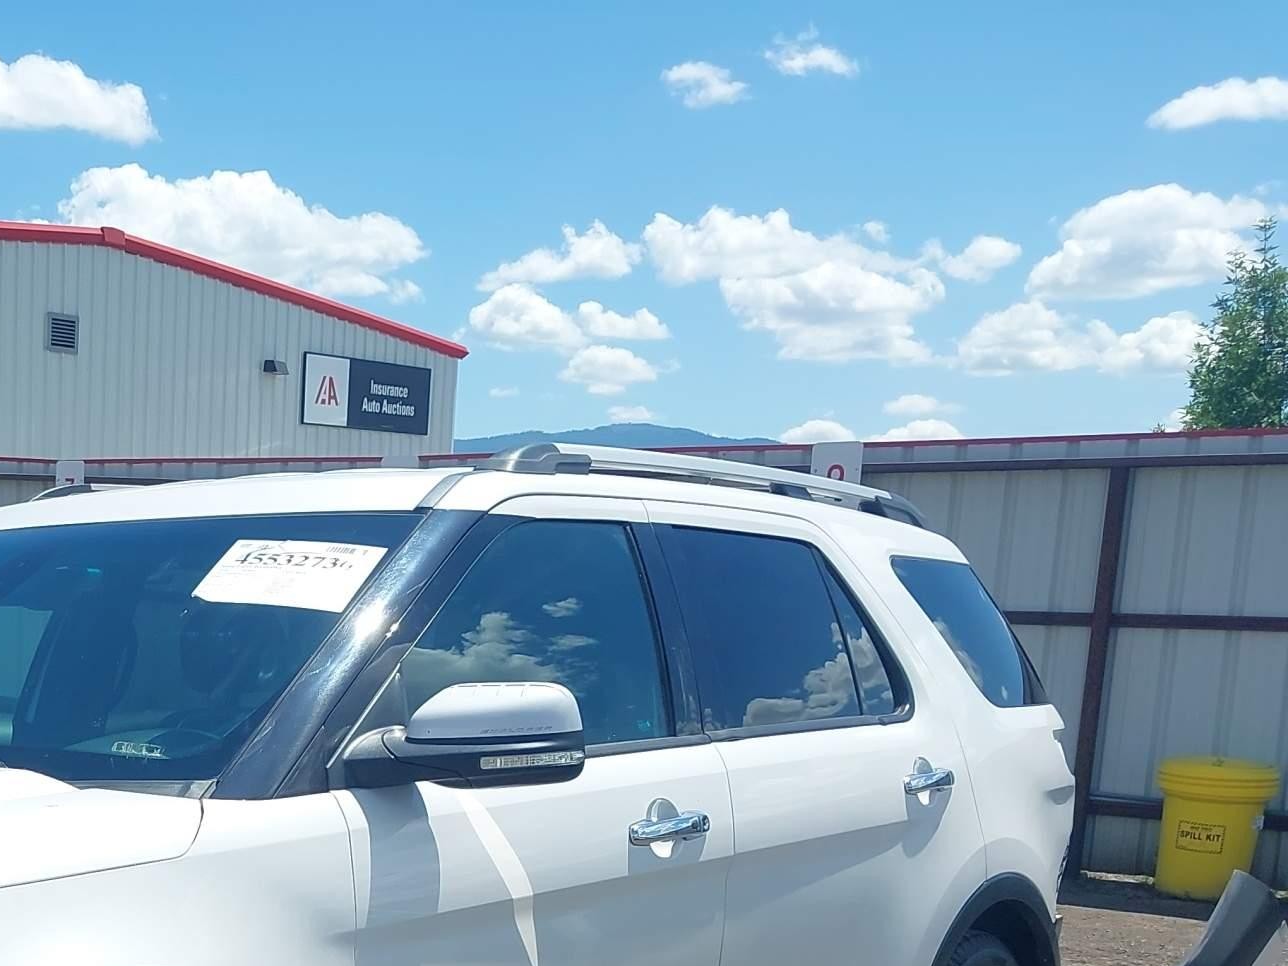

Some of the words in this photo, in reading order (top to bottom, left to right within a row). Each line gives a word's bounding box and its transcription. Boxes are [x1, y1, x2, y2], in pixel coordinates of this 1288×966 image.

[370, 380, 409, 398] Insurance
[361, 397, 380, 413] Auto
[381, 399, 415, 417] Auctions
[1179, 830, 1202, 841] SPILL
[1205, 833, 1222, 843] KIT
